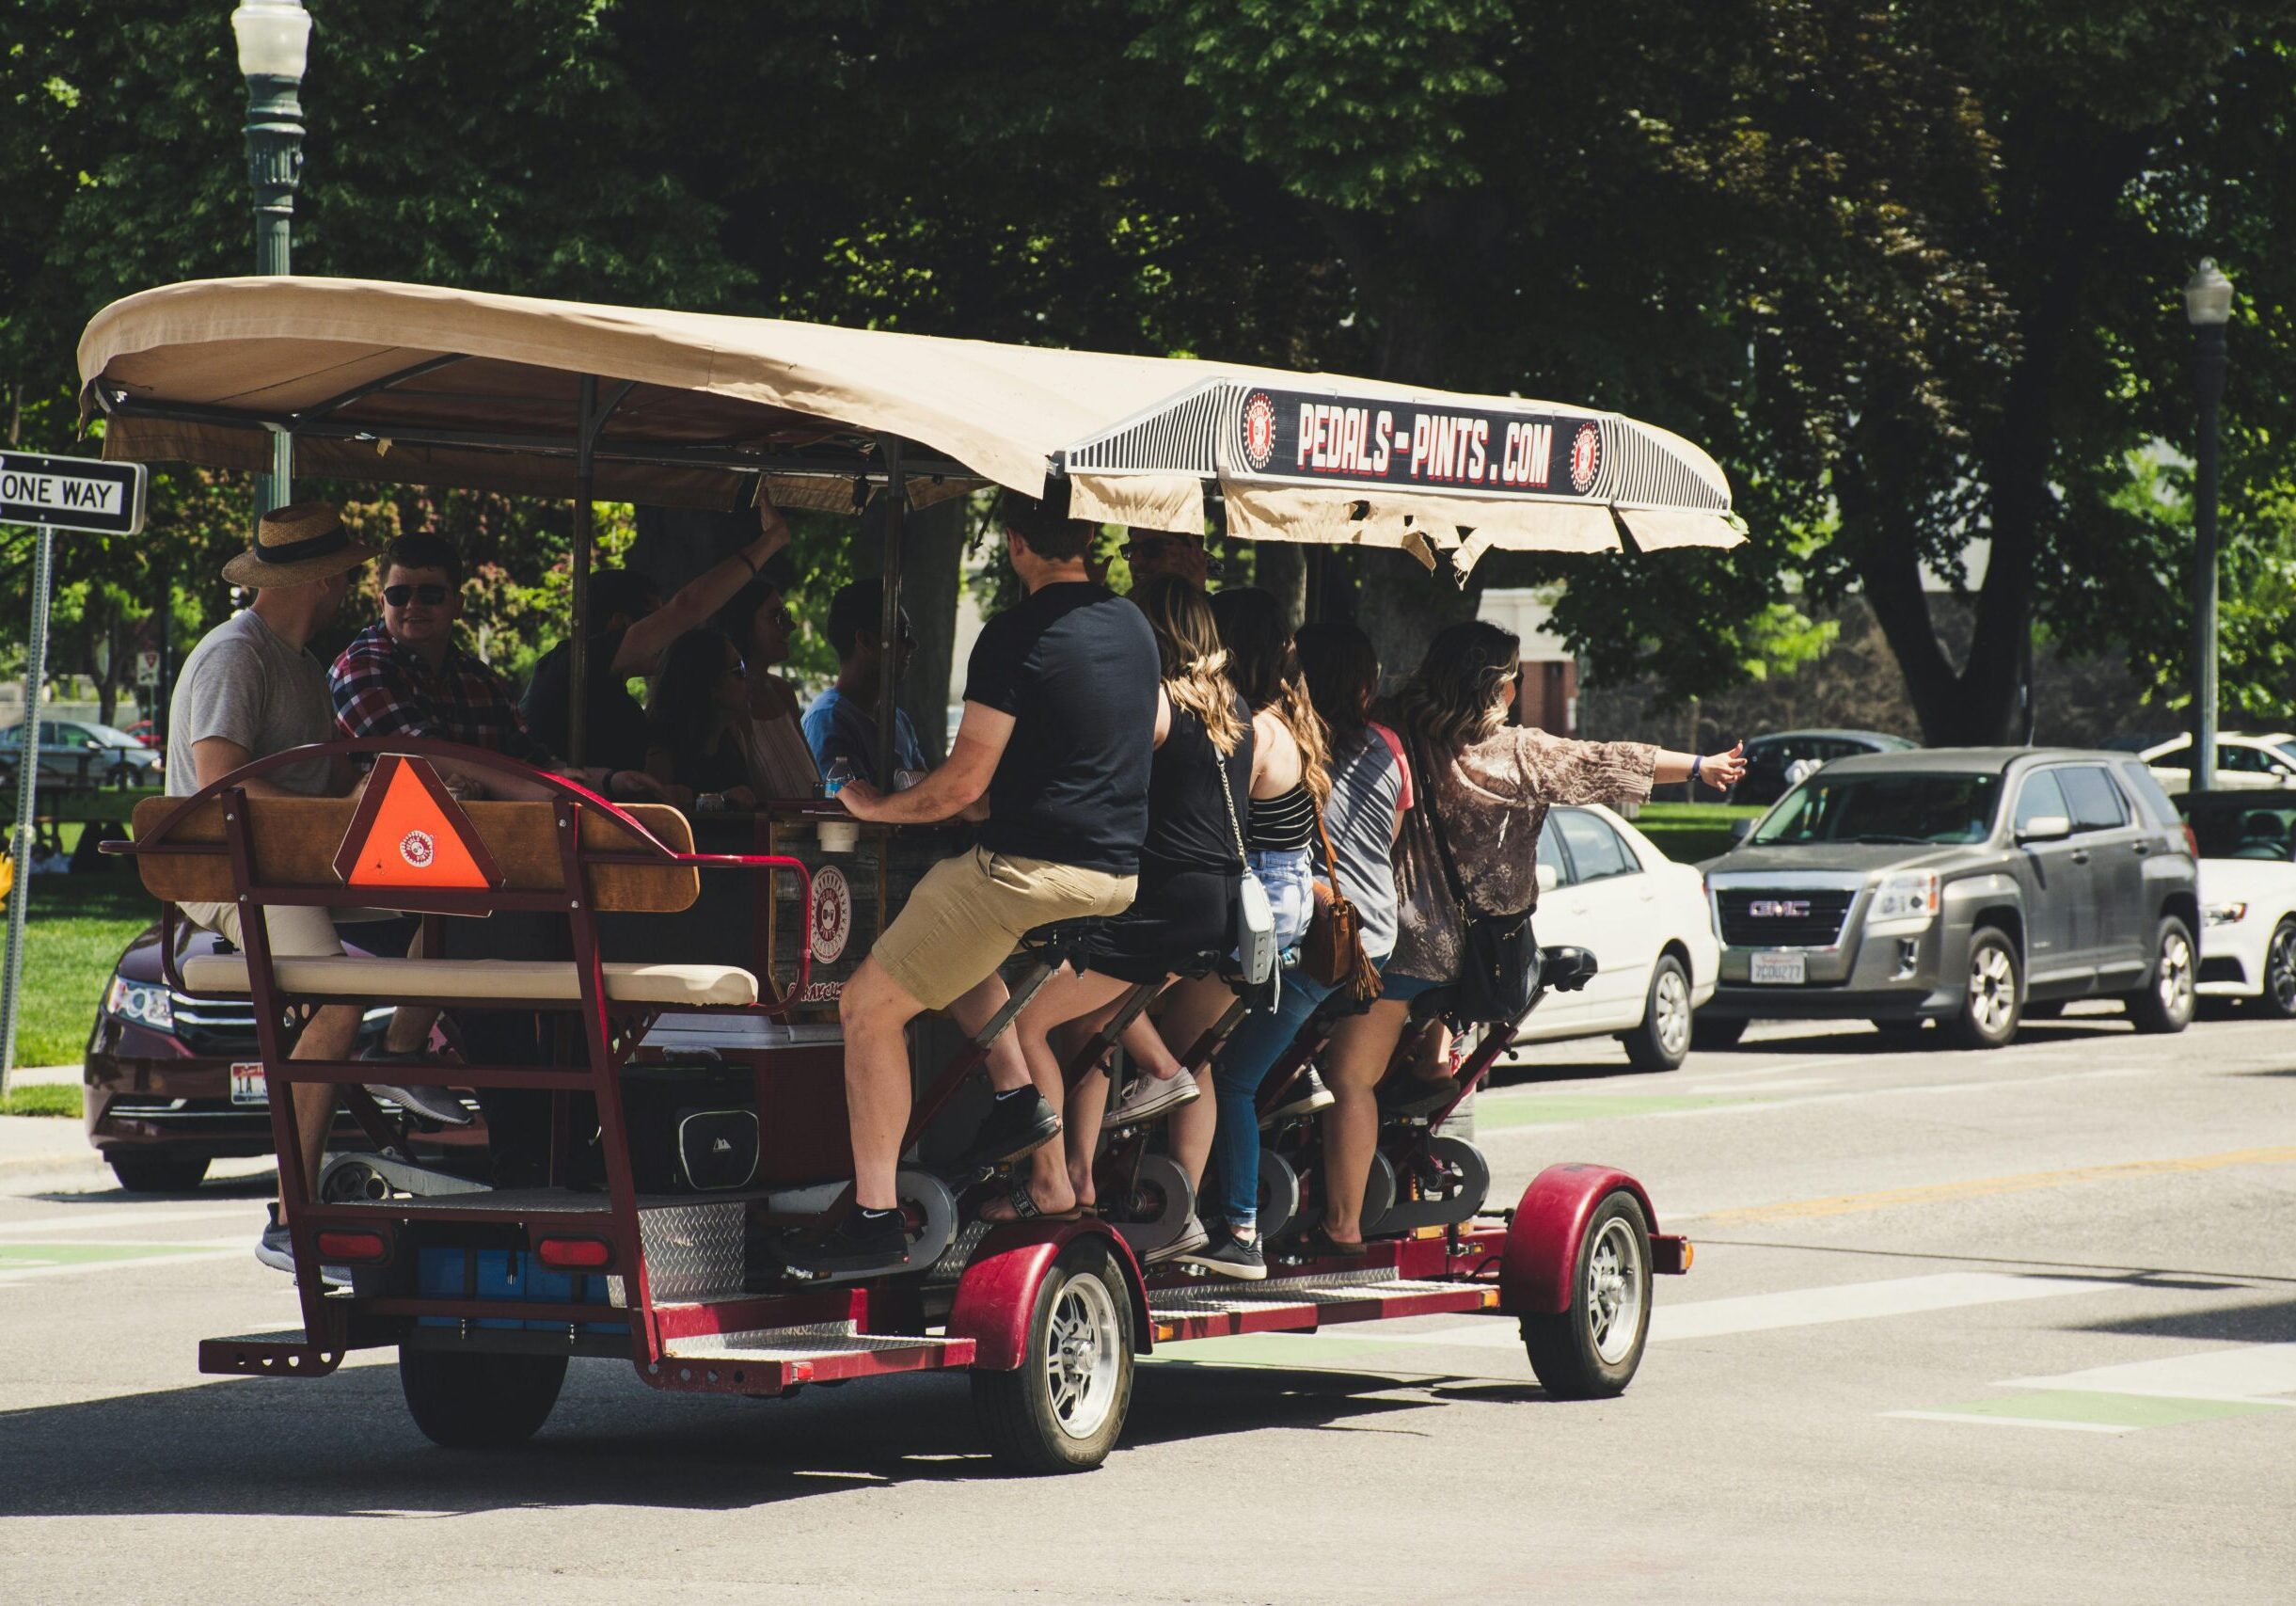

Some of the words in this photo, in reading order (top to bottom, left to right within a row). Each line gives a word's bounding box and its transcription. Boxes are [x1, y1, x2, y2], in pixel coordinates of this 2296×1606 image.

[2, 474, 52, 503] ONE
[62, 480, 112, 509] WAY
[1750, 899, 1811, 917] GMC
